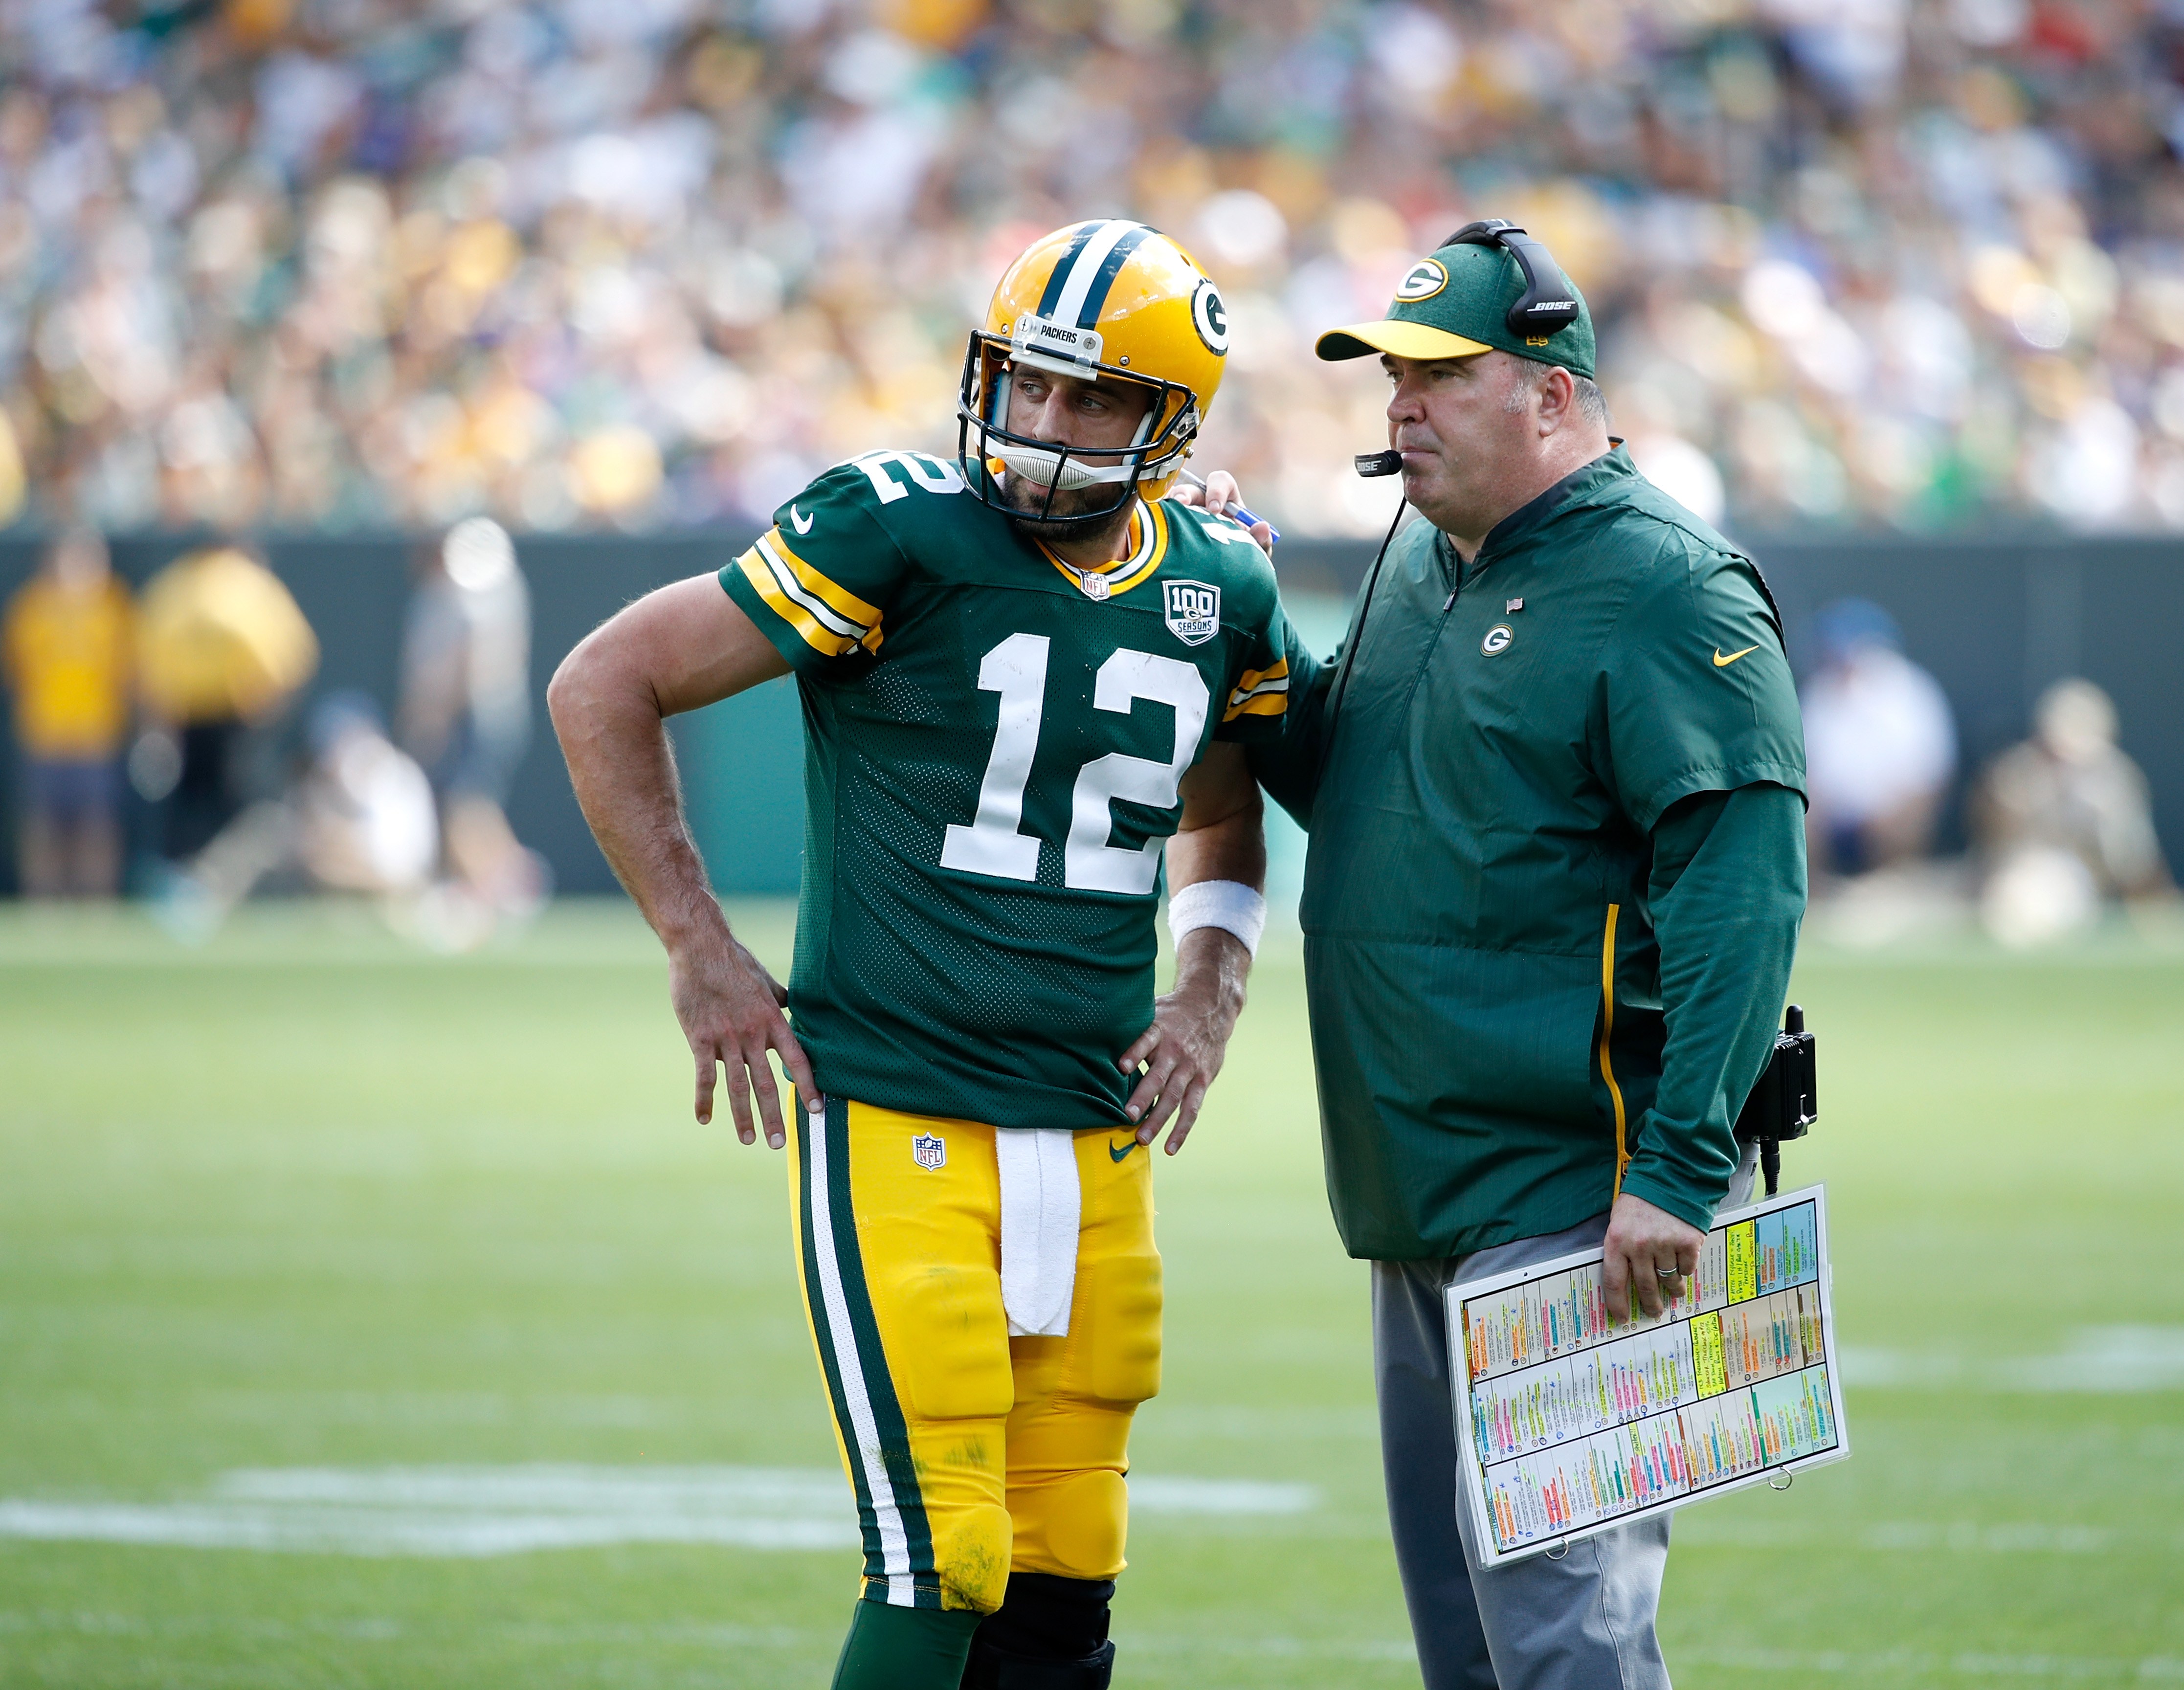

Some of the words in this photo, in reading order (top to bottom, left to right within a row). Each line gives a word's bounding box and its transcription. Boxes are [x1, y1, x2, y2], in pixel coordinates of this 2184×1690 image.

[1527, 301, 1576, 312] BOSE
[1041, 325, 1077, 344] PACKERS
[1085, 578, 1106, 595] NFL
[1172, 587, 1213, 617] 100
[1178, 620, 1212, 633] SEASONS
[939, 632, 1210, 894] 12
[918, 1149, 940, 1164] NFL
[1488, 1497, 1496, 1524] PERSONNEL
